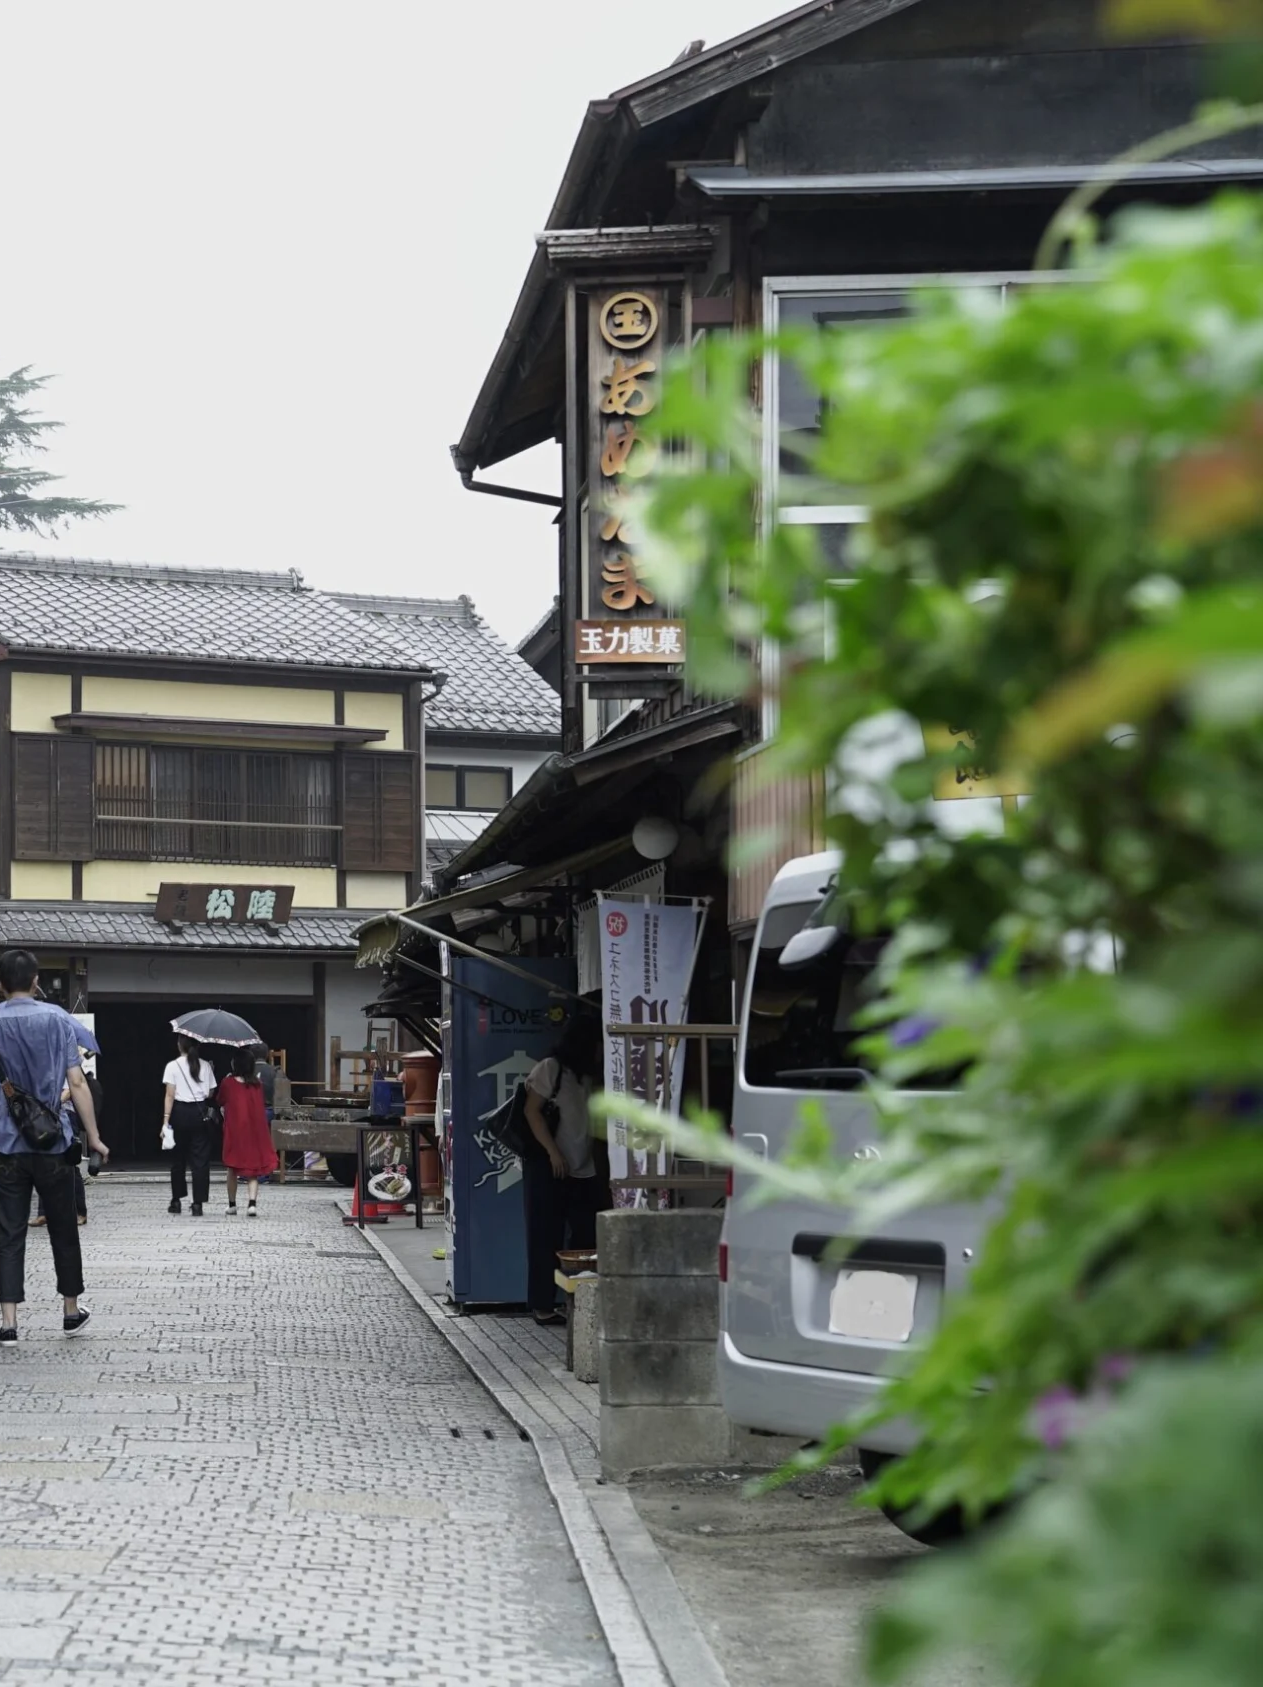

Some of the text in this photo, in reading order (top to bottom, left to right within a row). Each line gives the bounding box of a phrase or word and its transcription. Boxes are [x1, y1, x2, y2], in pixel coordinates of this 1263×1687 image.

[579, 625, 682, 655] 玉力製菓
[490, 1009, 544, 1025] LOVE
